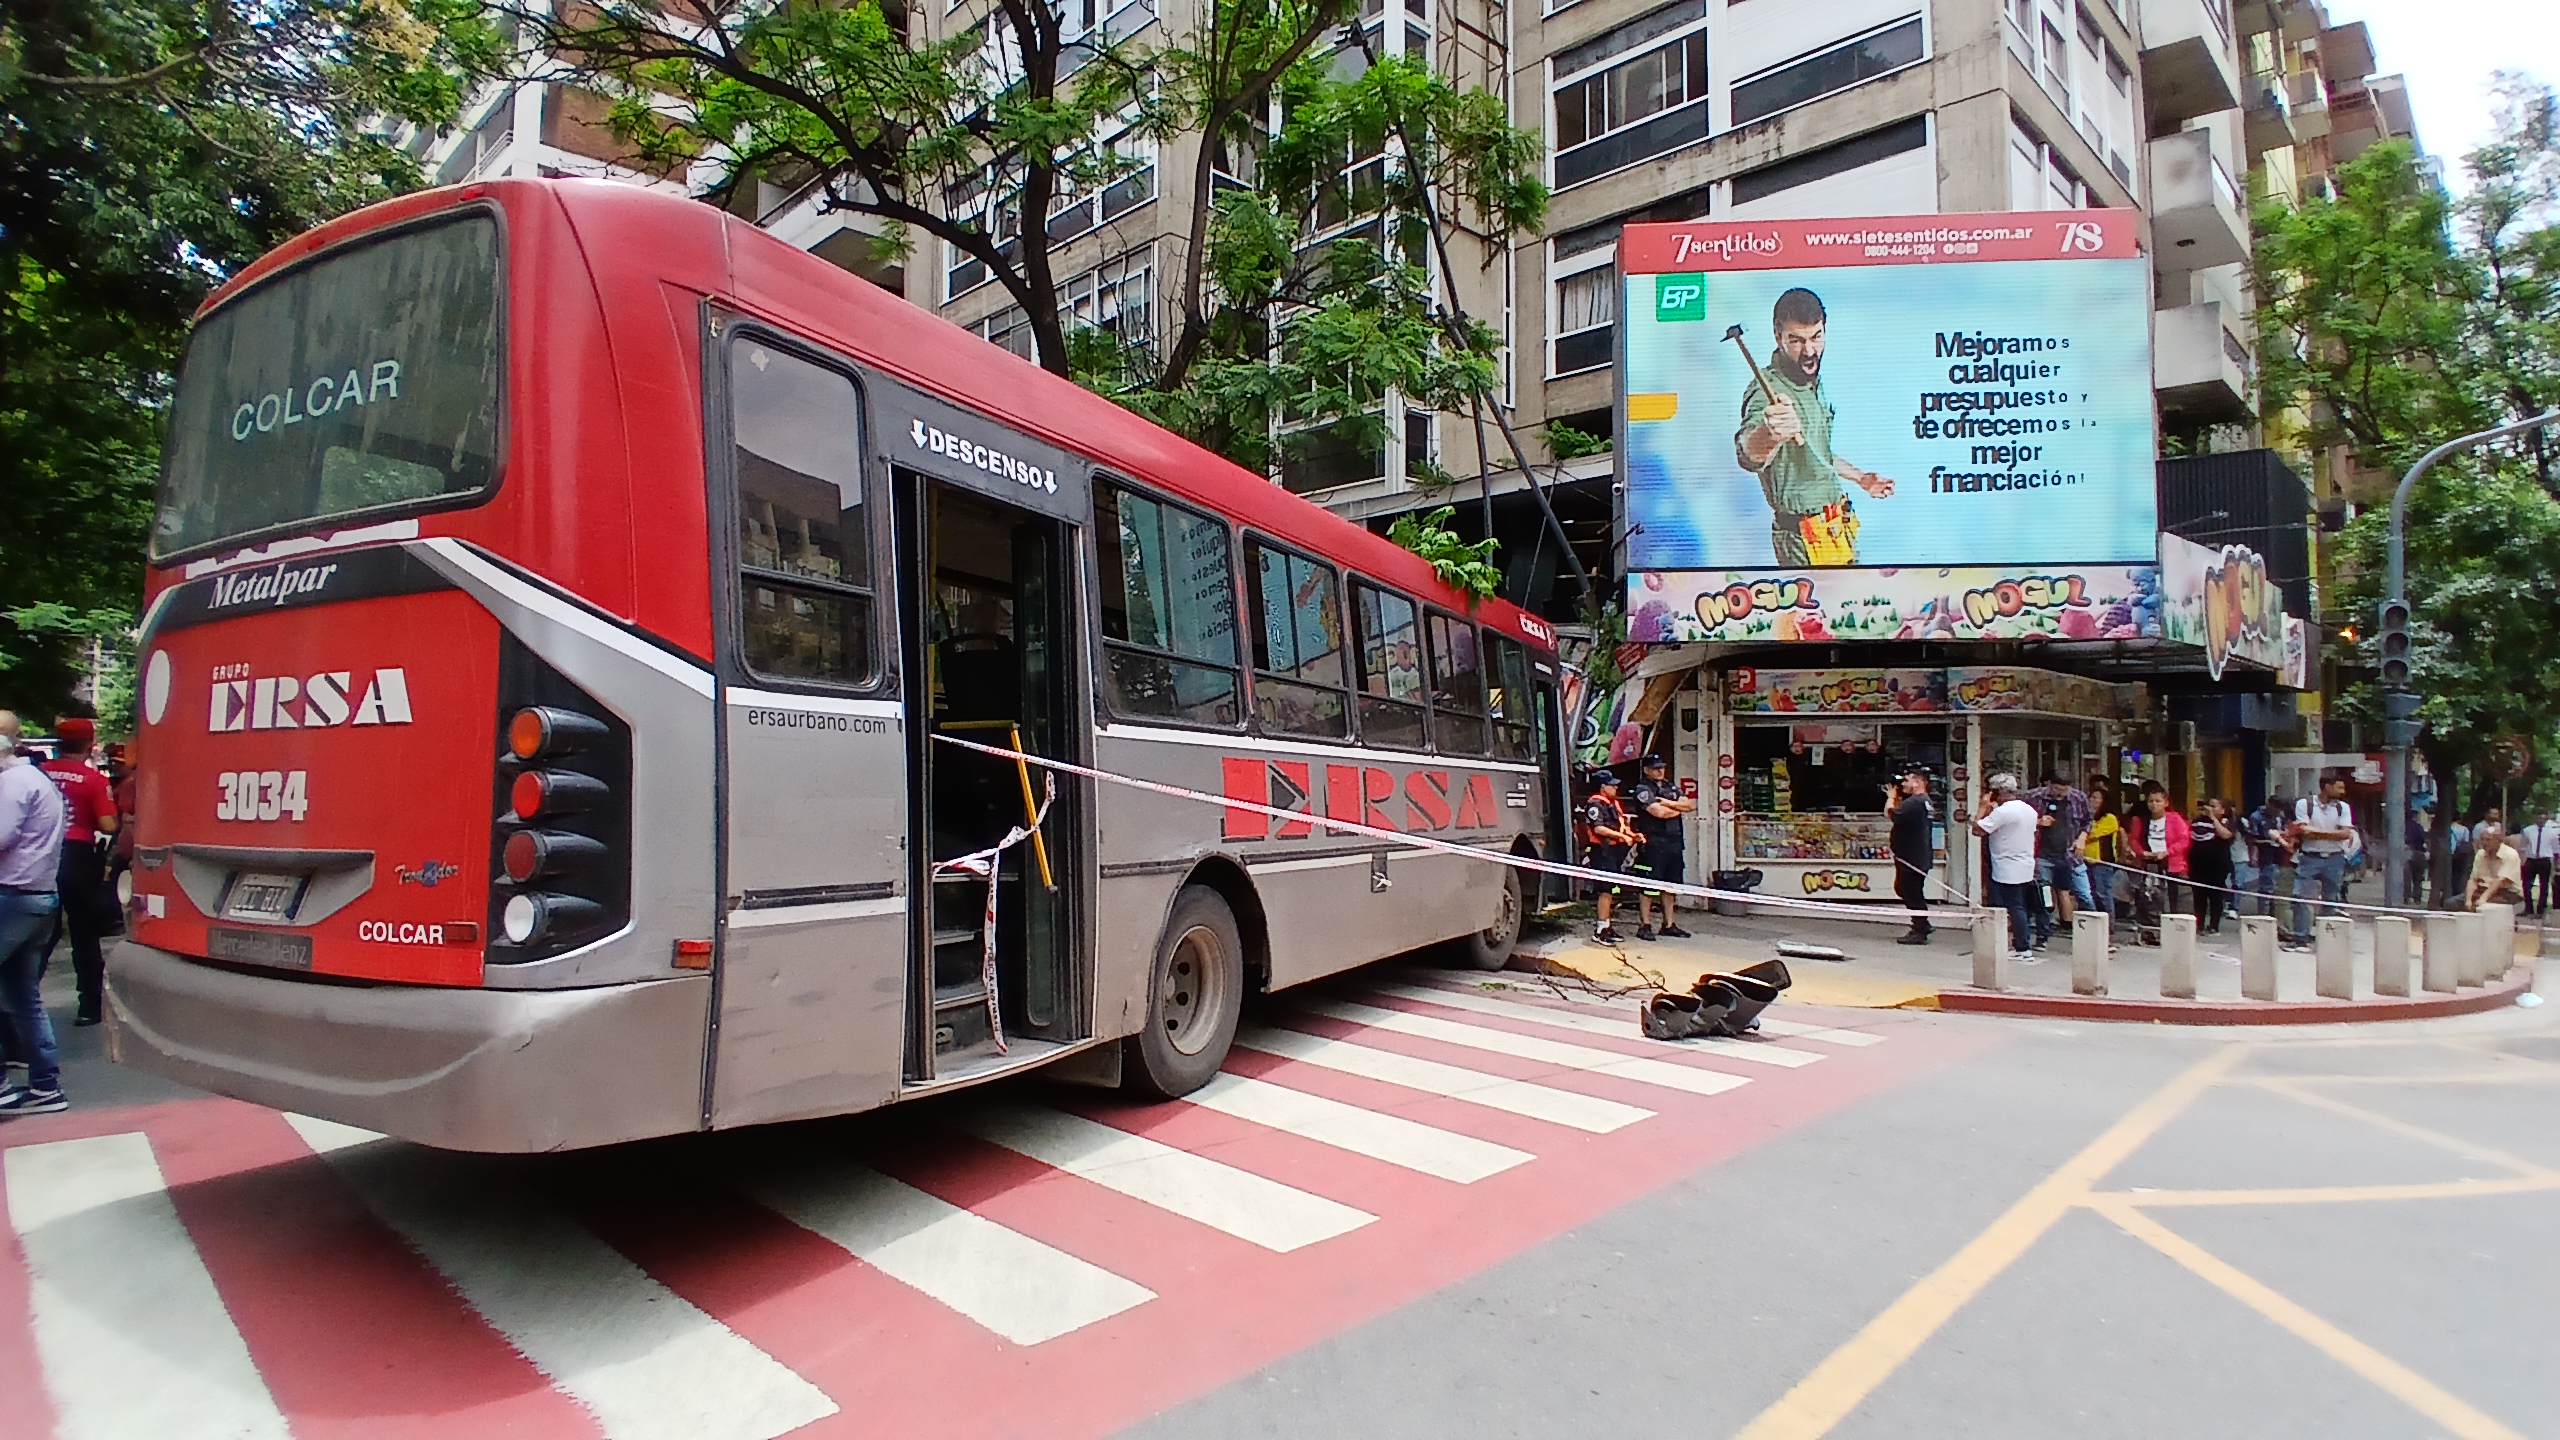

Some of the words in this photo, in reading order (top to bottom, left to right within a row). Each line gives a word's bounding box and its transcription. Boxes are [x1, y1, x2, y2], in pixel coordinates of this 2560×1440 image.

[1671, 231, 1783, 263] 7sentidos
[1805, 226, 2032, 247] www.sietesentidos.com.ar
[1661, 285, 1700, 309] BP
[1935, 331, 2070, 362] Mejoramos
[1949, 358, 2061, 387] cualquier
[232, 359, 400, 442] COLCAR
[1920, 390, 2068, 418] presupuesto
[1913, 415, 1939, 439] te
[1942, 412, 2071, 439] ofrecemos
[929, 427, 1043, 489] DESCENSO
[1971, 440, 2043, 472] mejor
[207, 562, 338, 609] Metalpar
[1695, 578, 1820, 631] MOGUL
[1963, 575, 2092, 628] MOGUL
[213, 663, 249, 680] GRUPO
[208, 668, 414, 732] ERSA
[748, 708, 886, 734] ersaurbano.com
[216, 770, 308, 821] 3034
[1220, 757, 1499, 843] ERSA
[1802, 870, 1870, 894] MOGUL
[359, 921, 444, 945] COLCAR
